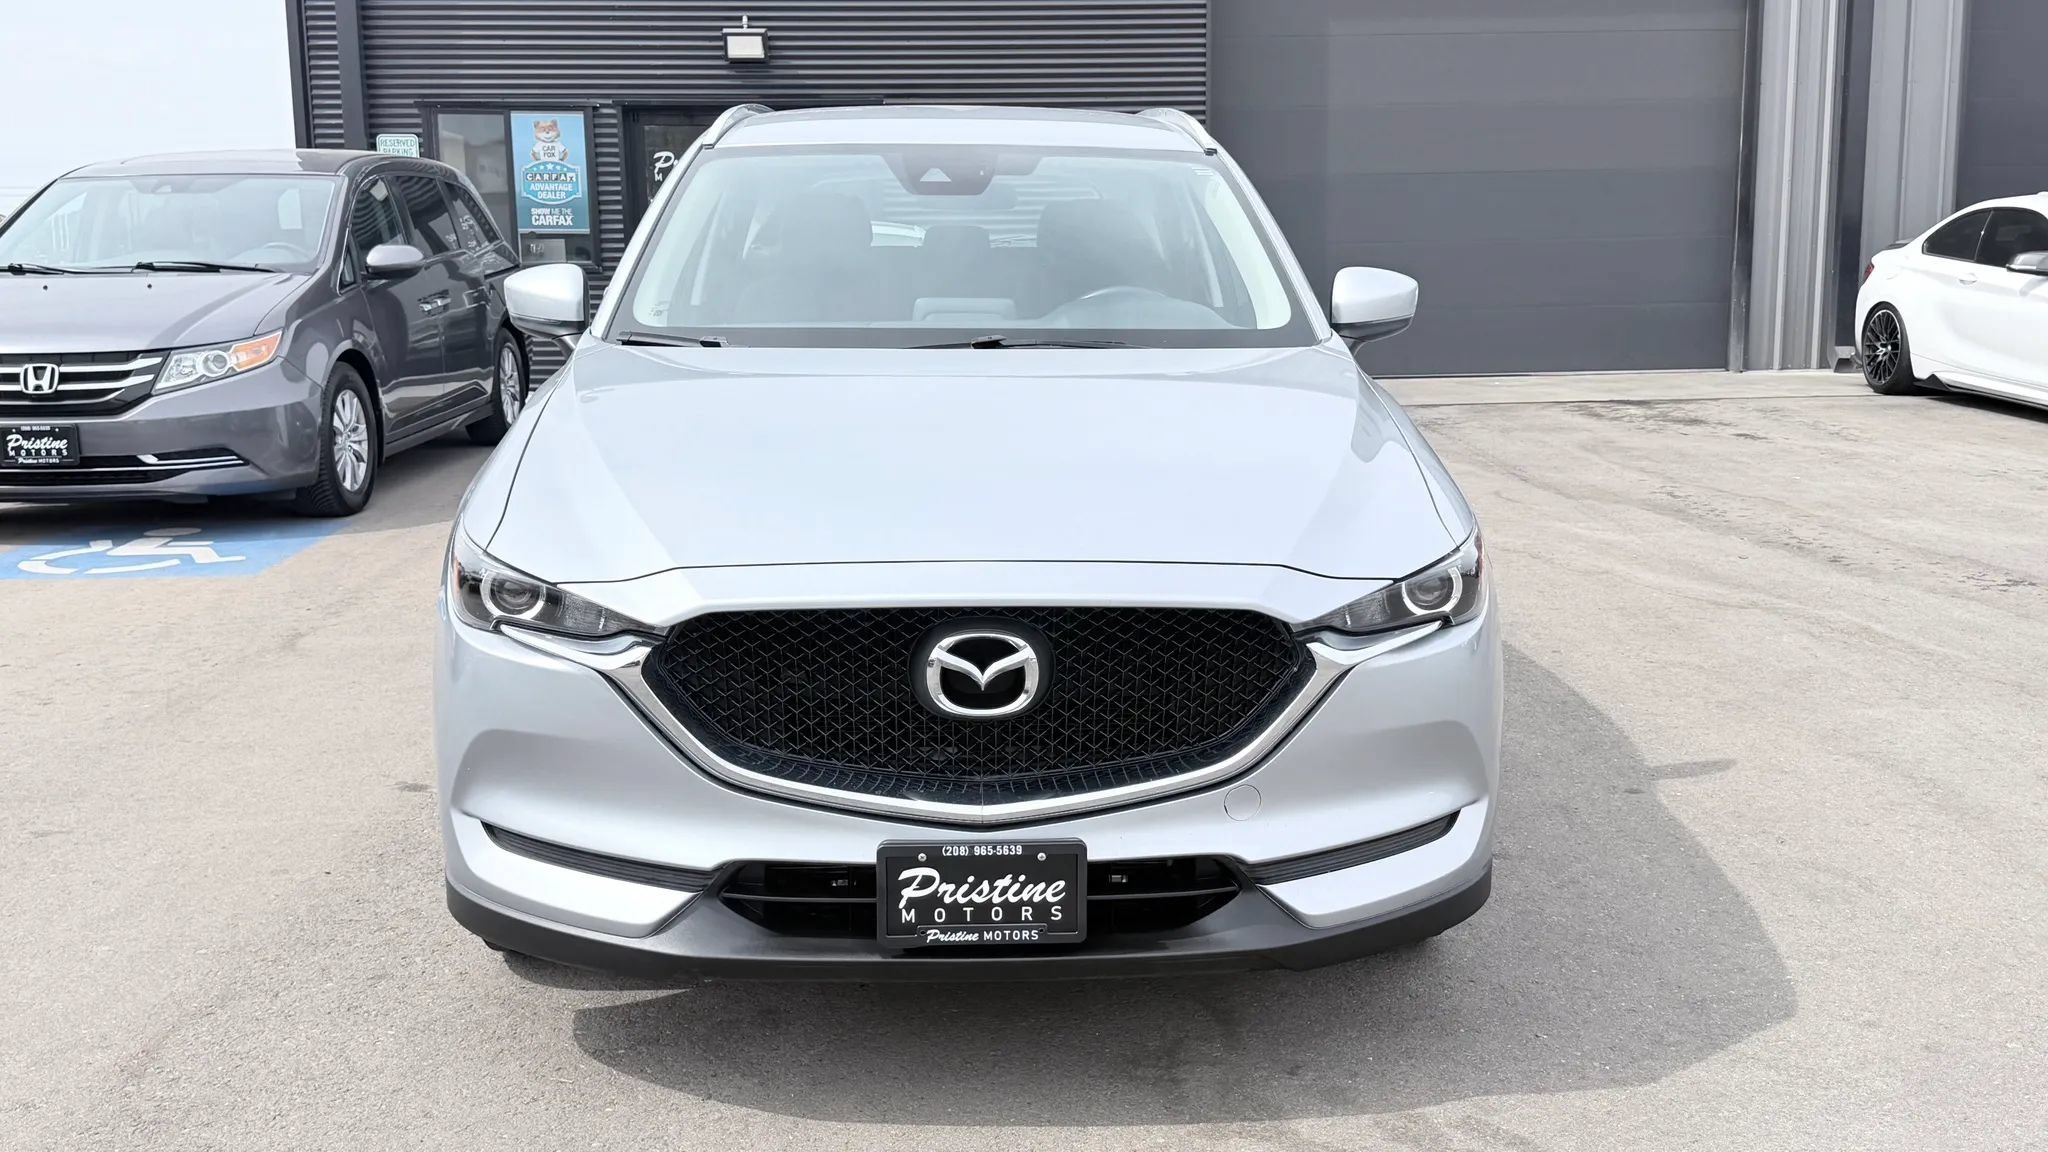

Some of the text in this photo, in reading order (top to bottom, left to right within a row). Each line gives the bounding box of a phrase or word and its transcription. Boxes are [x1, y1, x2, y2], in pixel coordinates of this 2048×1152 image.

[380, 138, 415, 147] RESERVED
[526, 172, 577, 182] CARFAX
[529, 182, 573, 191] ADVANTAGE
[537, 191, 566, 199] DEALER
[530, 207, 551, 215] SHOW
[531, 216, 574, 226] CARFAX
[6, 433, 68, 450] Pristine
[942, 845, 1023, 856] (208) 965-5639
[898, 867, 1066, 910] Pristine
[902, 906, 1062, 923] MOTORS
[926, 928, 1039, 944] Pristine MOTORS
